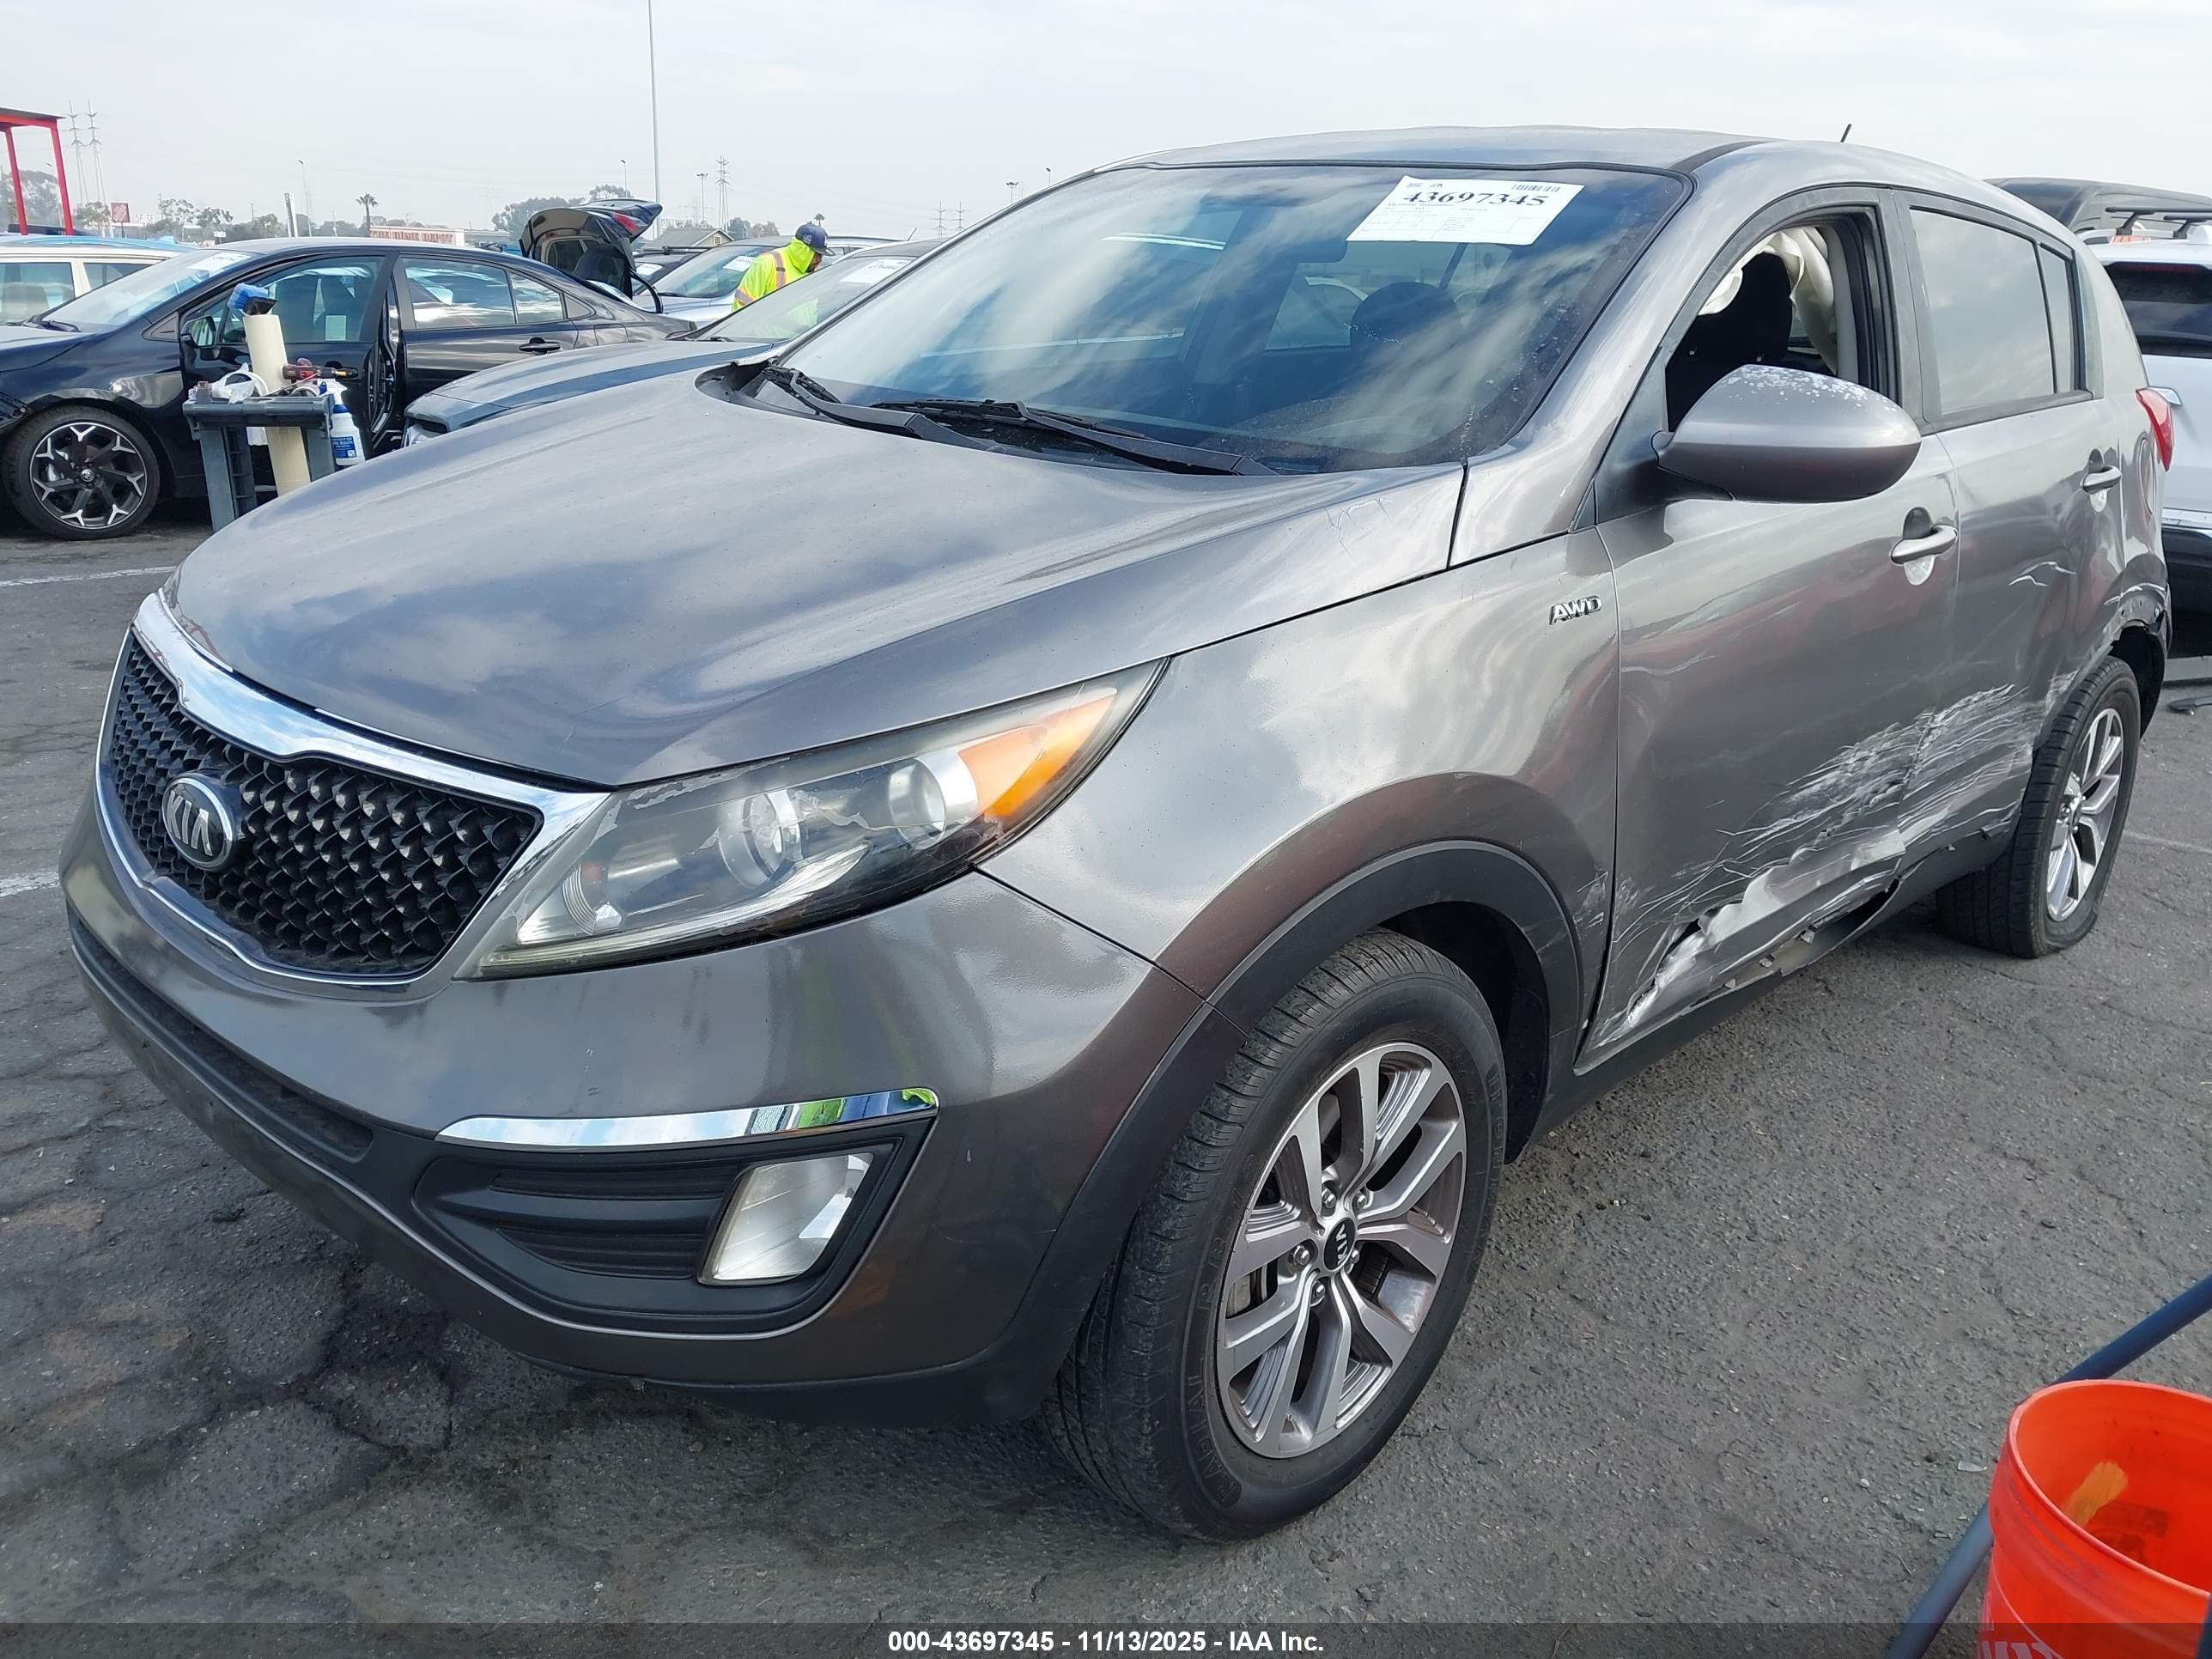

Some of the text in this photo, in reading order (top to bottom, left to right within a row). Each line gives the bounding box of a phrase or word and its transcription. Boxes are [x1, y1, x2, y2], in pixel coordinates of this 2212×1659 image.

[1403, 191, 1549, 206] 43697345
[422, 233, 453, 244] DEPOT
[1549, 595, 1602, 625] AWD
